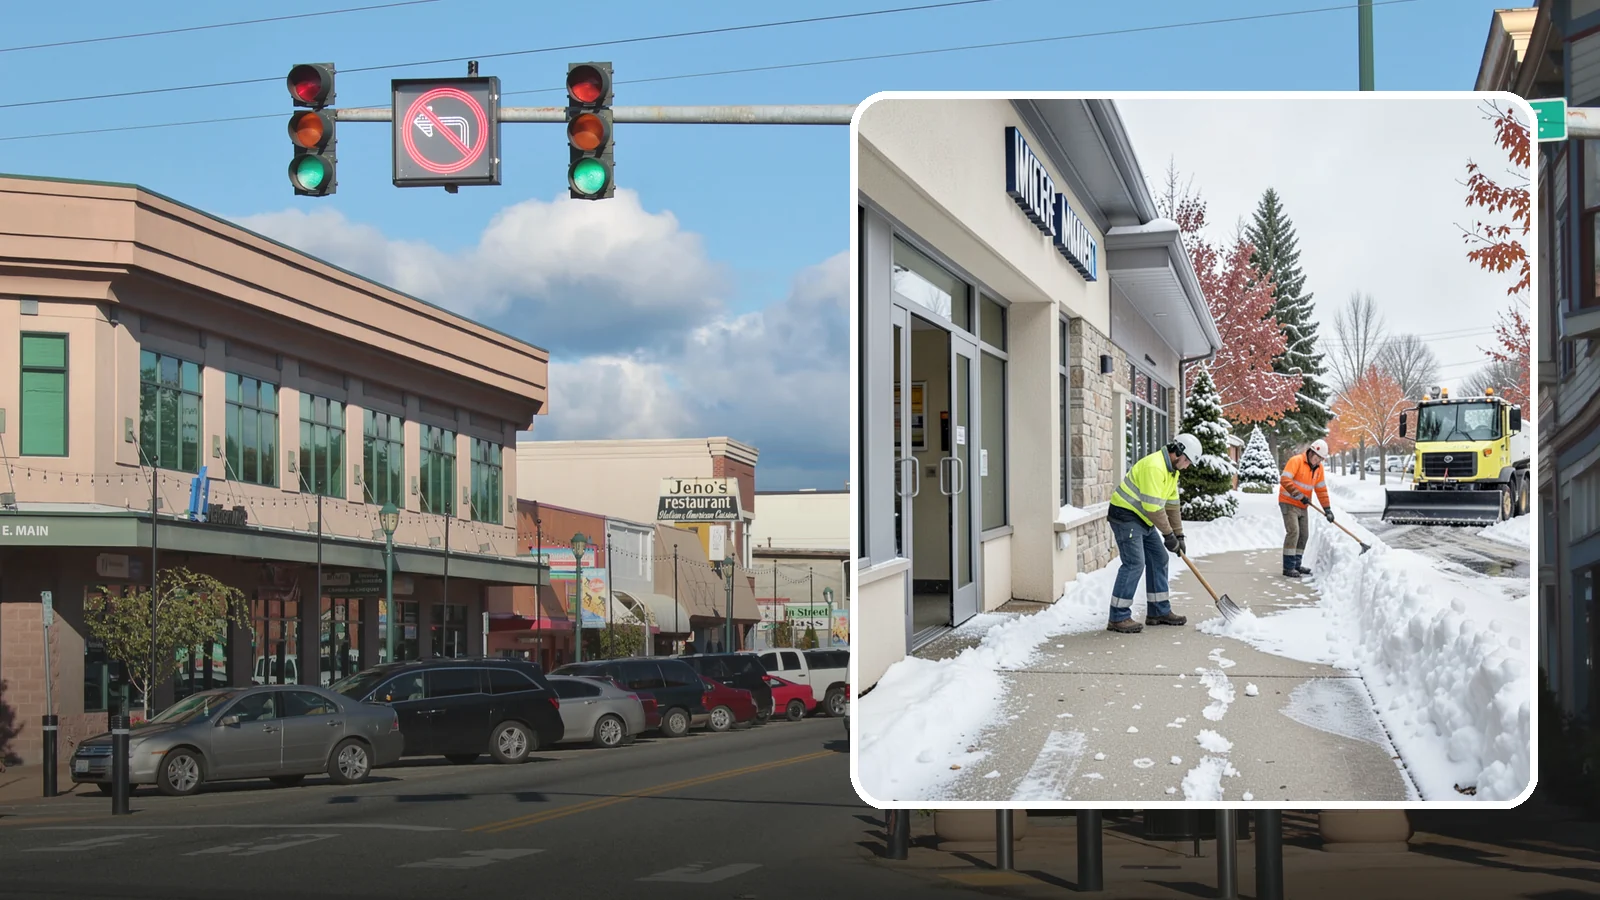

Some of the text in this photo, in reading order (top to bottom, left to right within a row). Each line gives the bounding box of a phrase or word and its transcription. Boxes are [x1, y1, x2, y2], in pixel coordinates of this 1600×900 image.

[669, 480, 727, 494] Jeno's
[665, 496, 731, 509] restaurant
[658, 509, 681, 519] Italian
[685, 509, 714, 519] American
[714, 509, 738, 519] Cuisine
[2, 525, 49, 536] E. MAIN
[797, 607, 829, 617] Street
